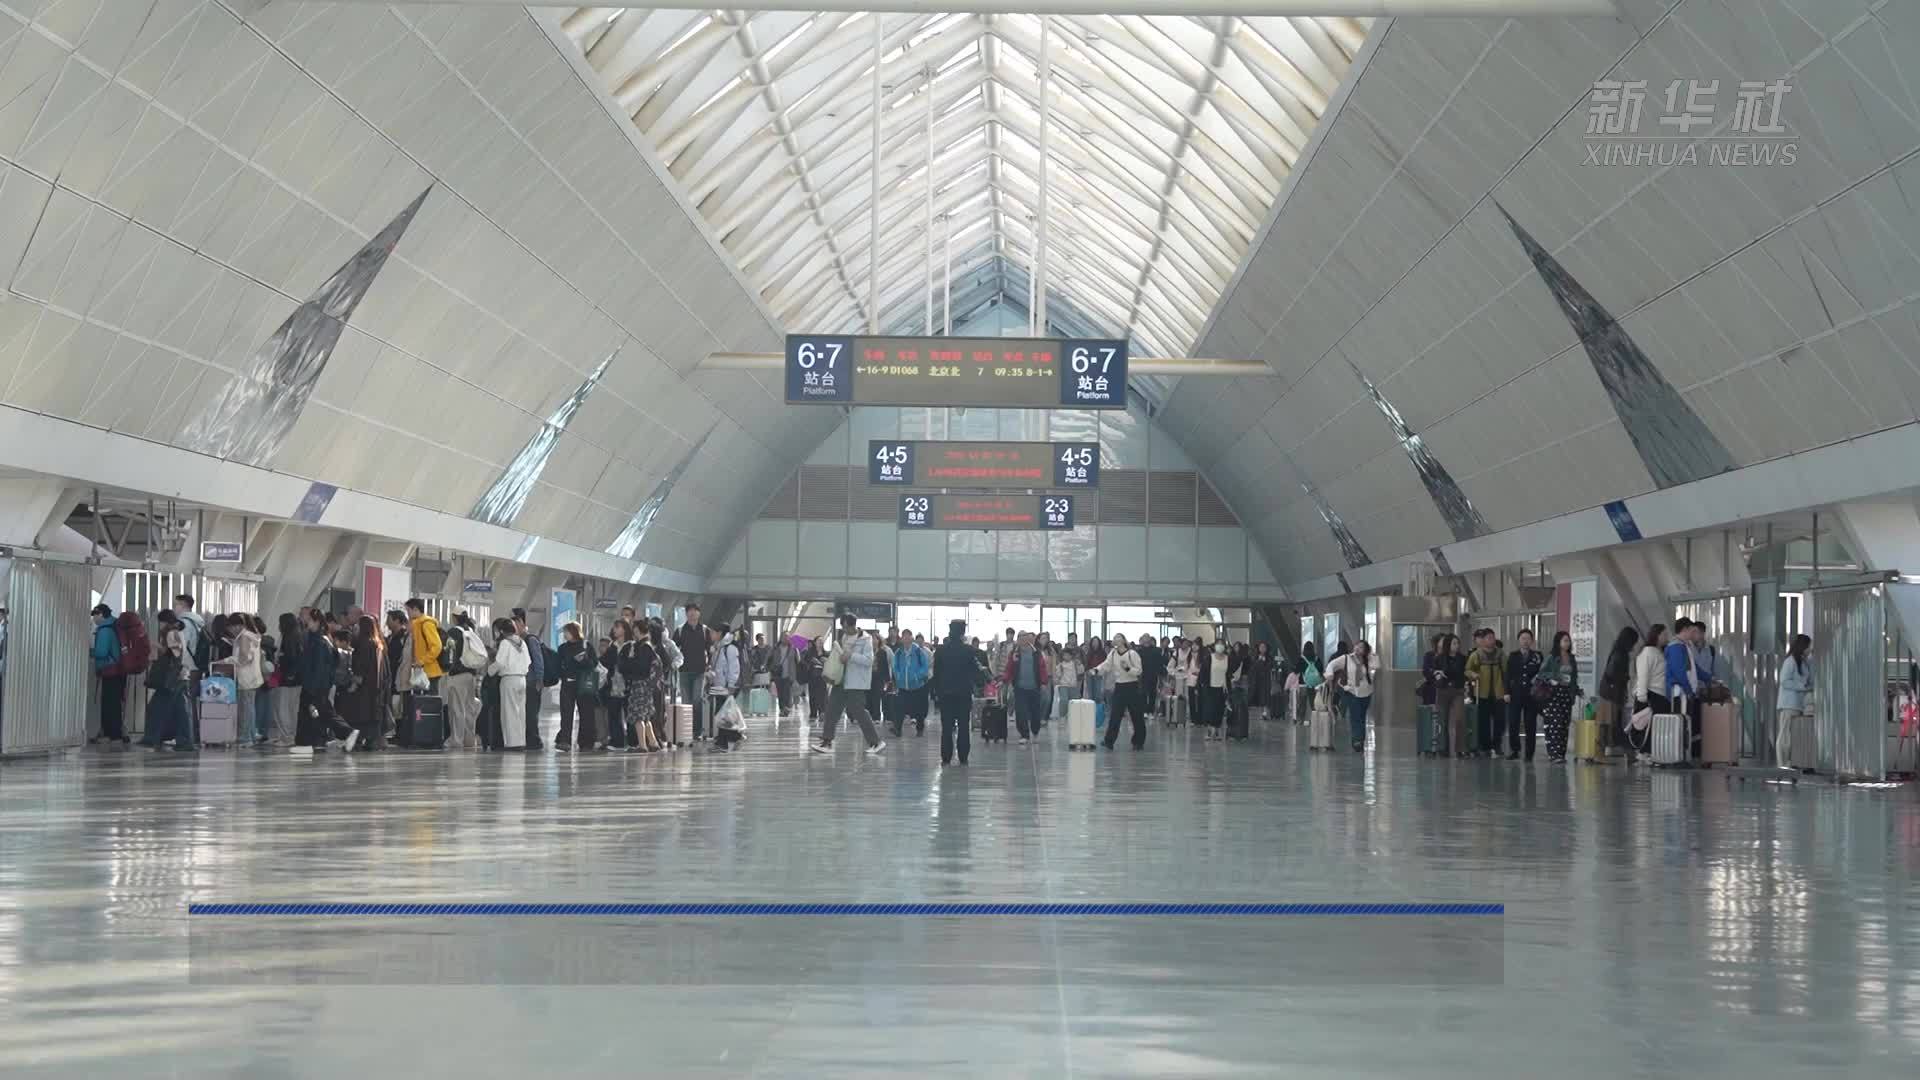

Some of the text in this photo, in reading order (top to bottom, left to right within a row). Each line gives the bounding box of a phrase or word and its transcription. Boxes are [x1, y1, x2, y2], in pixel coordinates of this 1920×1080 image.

[798, 343, 843, 369] 6·7
[1072, 347, 1117, 373] 6·7
[804, 371, 836, 387] 站台
[977, 367, 984, 377] 7
[1078, 375, 1110, 392] 站台
[803, 387, 837, 396] Platform
[1076, 391, 1110, 401] Platform
[876, 445, 908, 463] 4·5
[1061, 447, 1093, 466] 4·5
[881, 464, 902, 475] 站台
[1066, 467, 1087, 478] 站台
[904, 497, 929, 512] 2·3
[1045, 499, 1069, 513] 2·3
